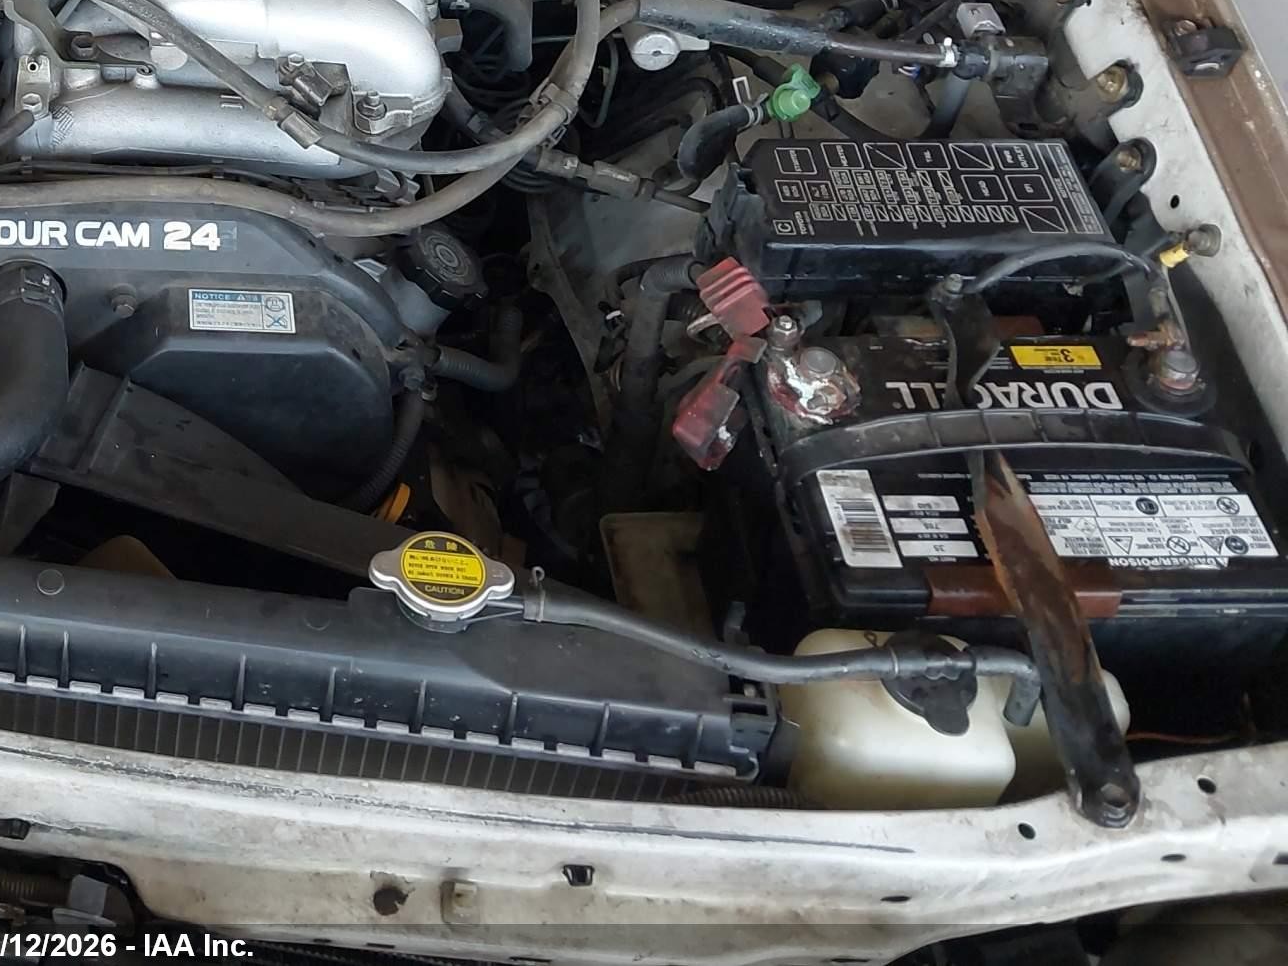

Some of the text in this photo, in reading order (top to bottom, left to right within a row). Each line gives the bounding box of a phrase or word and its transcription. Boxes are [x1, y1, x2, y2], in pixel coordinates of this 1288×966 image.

[777, 222, 792, 233] C
[795, 211, 807, 235] TOYOTA
[75, 220, 150, 248] CAM
[163, 221, 221, 251] 24
[194, 292, 232, 301] NOTICE
[1060, 348, 1075, 363] 3
[885, 381, 1124, 410] DURACLL
[424, 585, 465, 595] CAUTION
